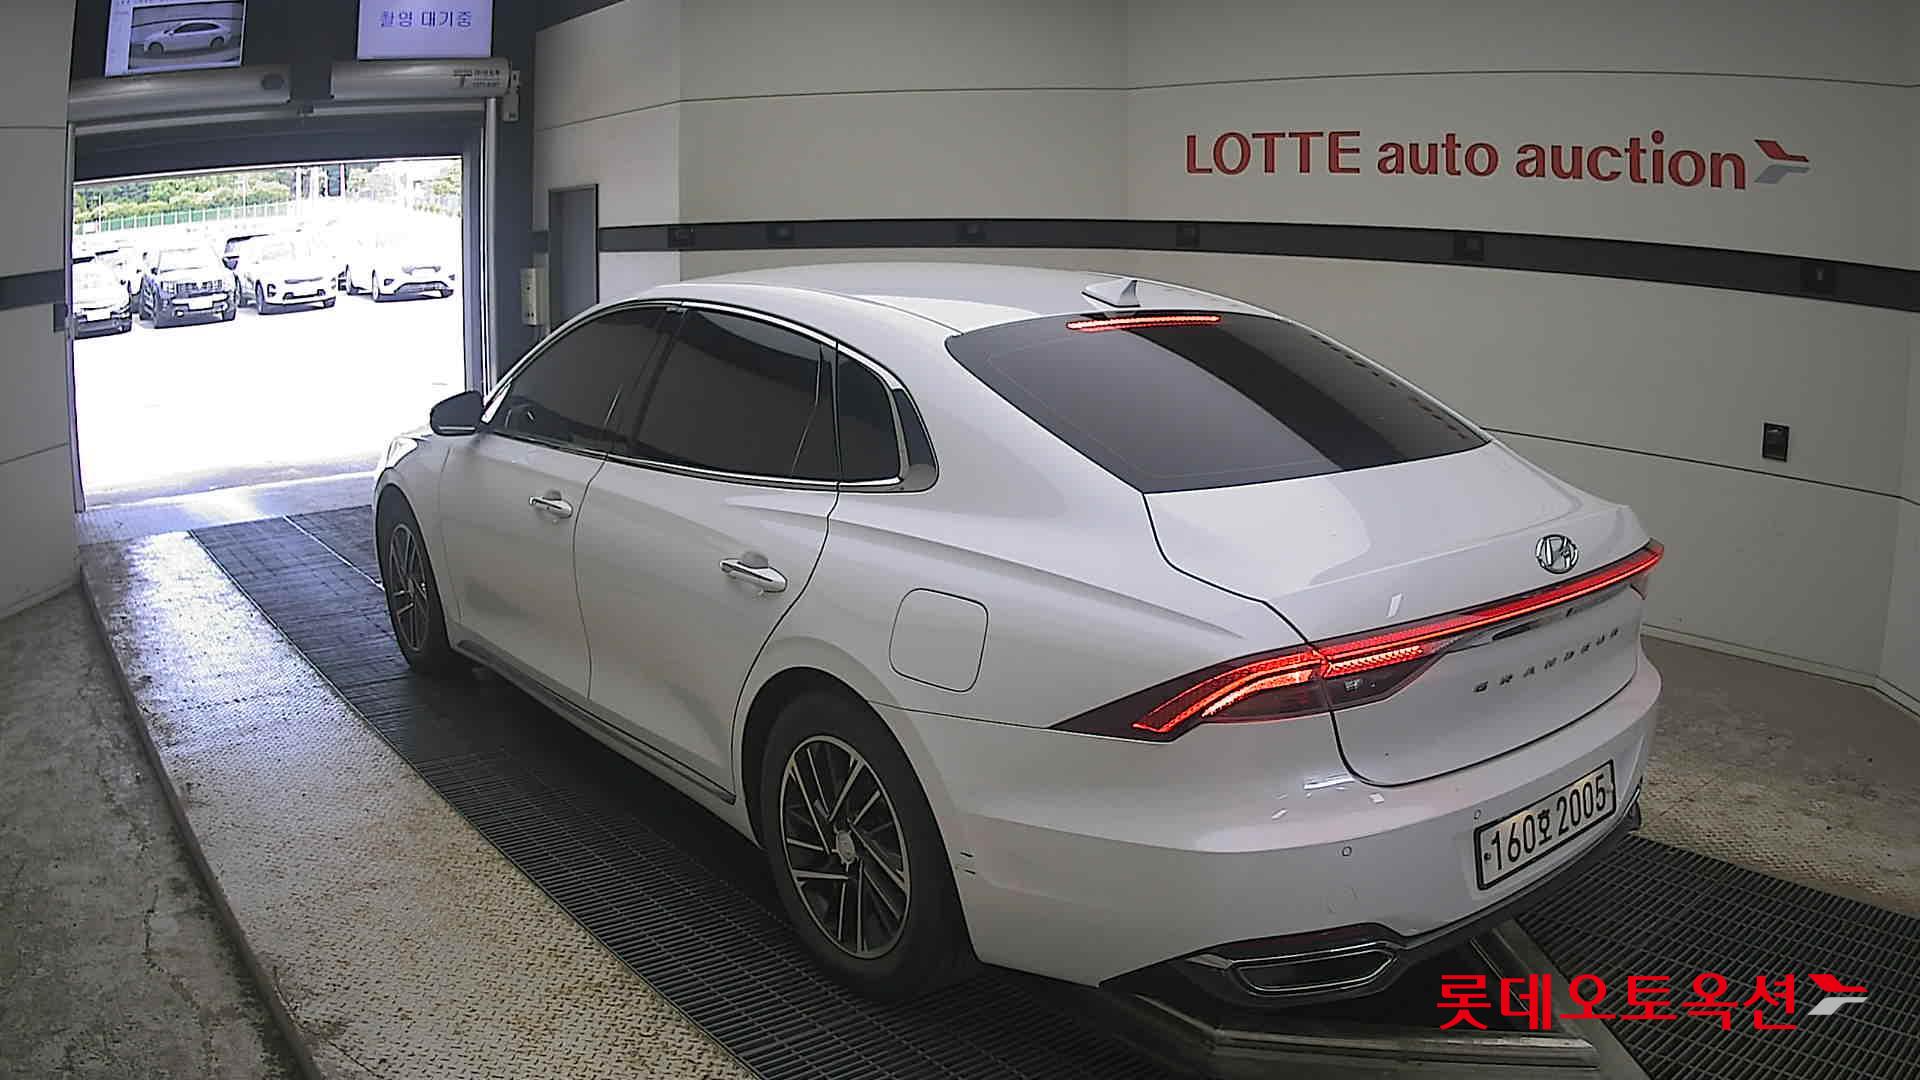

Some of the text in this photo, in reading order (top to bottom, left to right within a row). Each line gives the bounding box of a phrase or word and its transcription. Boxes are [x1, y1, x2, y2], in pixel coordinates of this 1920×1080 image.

[421, 10, 473, 28] 대기중
[1185, 130, 1746, 189] LOTTE auto auction
[1556, 773, 1607, 837] 2005
